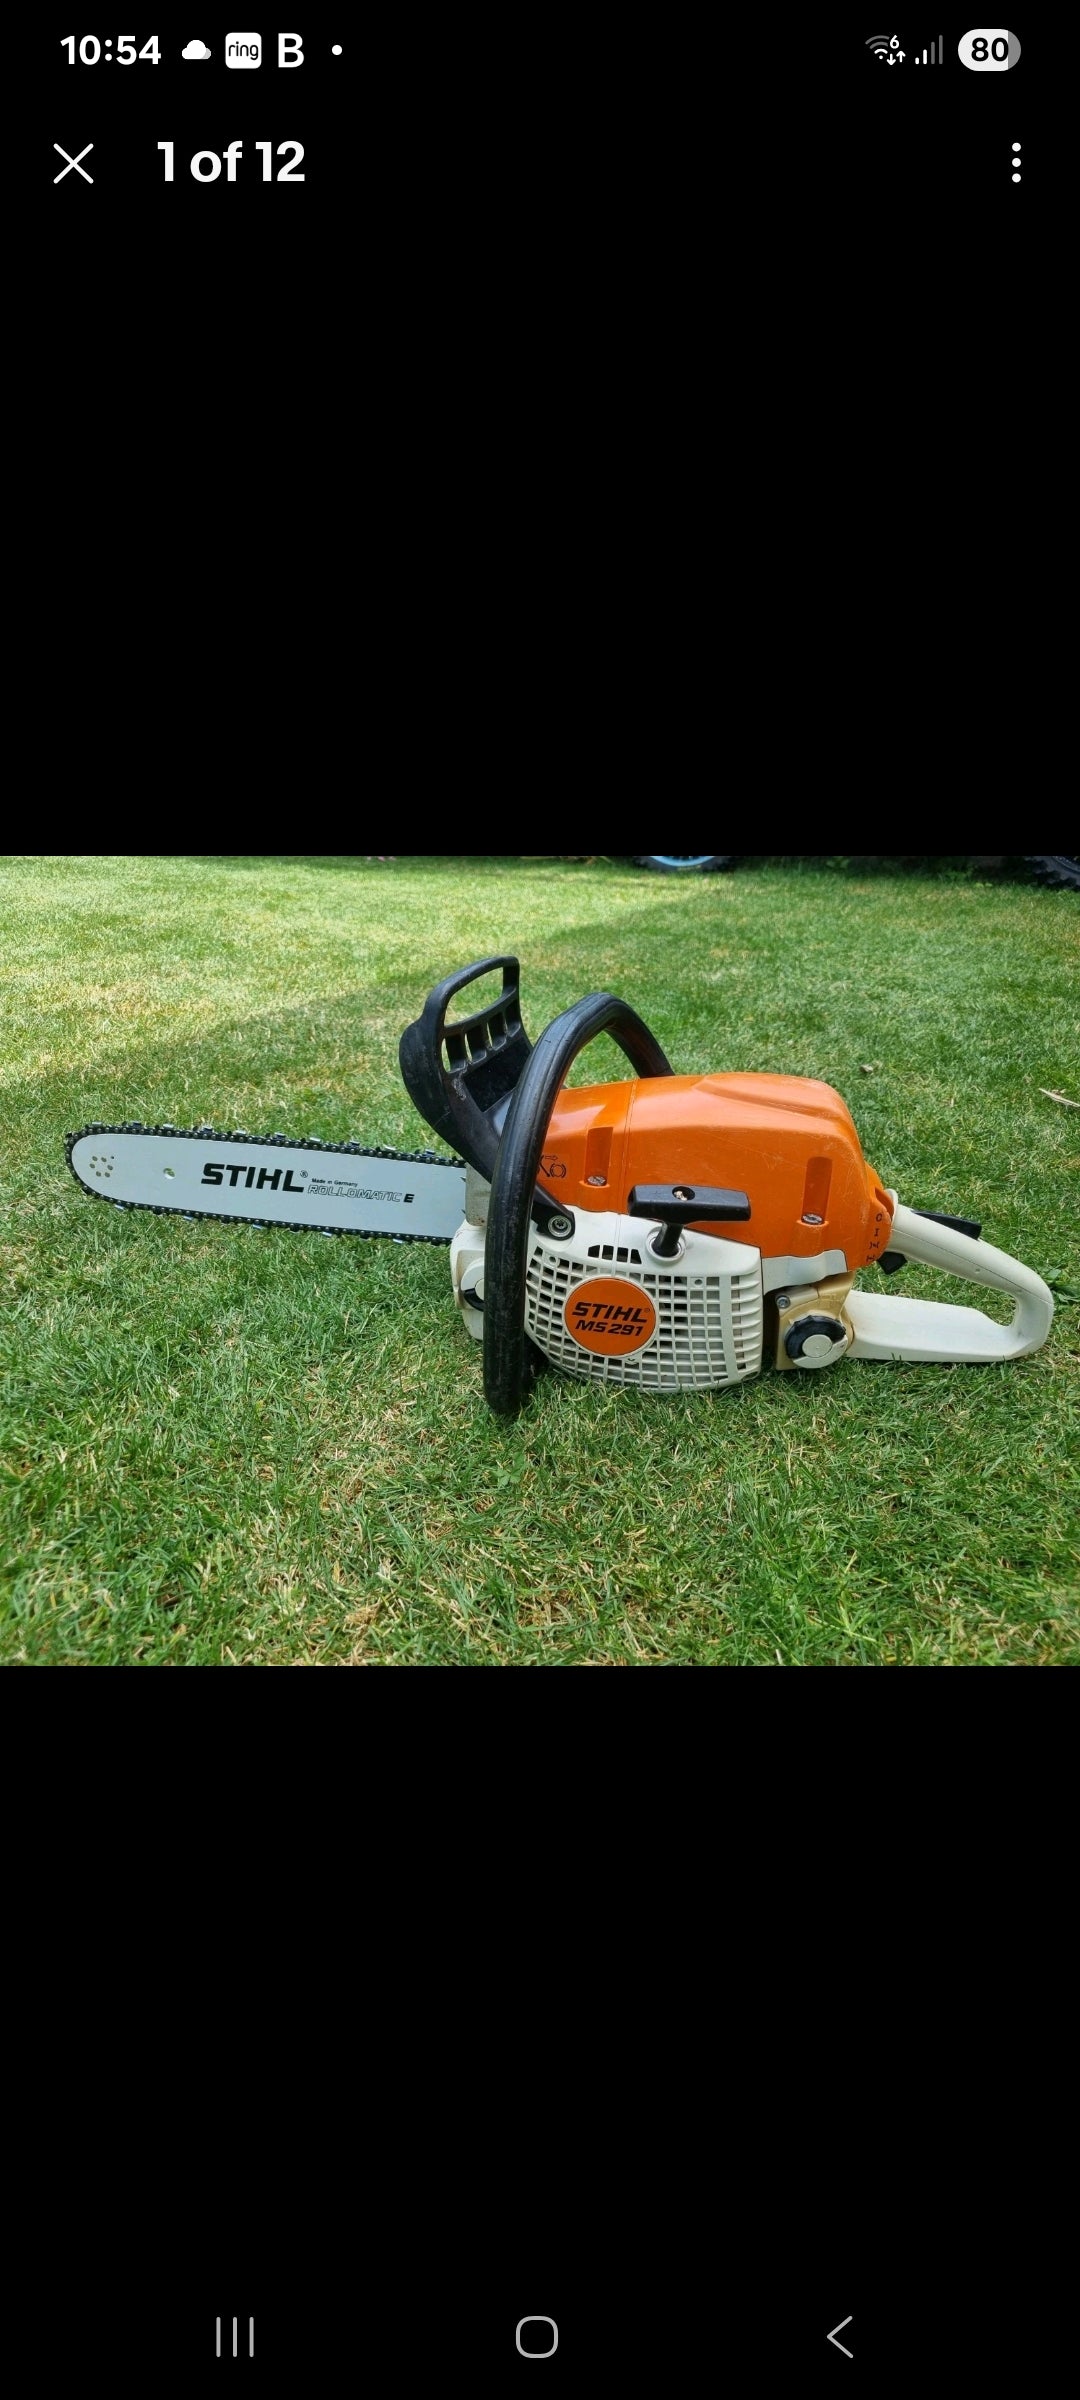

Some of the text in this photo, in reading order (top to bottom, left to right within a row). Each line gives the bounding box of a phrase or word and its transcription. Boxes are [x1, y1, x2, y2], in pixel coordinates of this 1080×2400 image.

[200, 1162, 305, 1193] STIHL
[307, 1184, 415, 1204] ROLLOMATIC E
[572, 1301, 649, 1324] STIHL
[575, 1319, 644, 1337] MS 291
